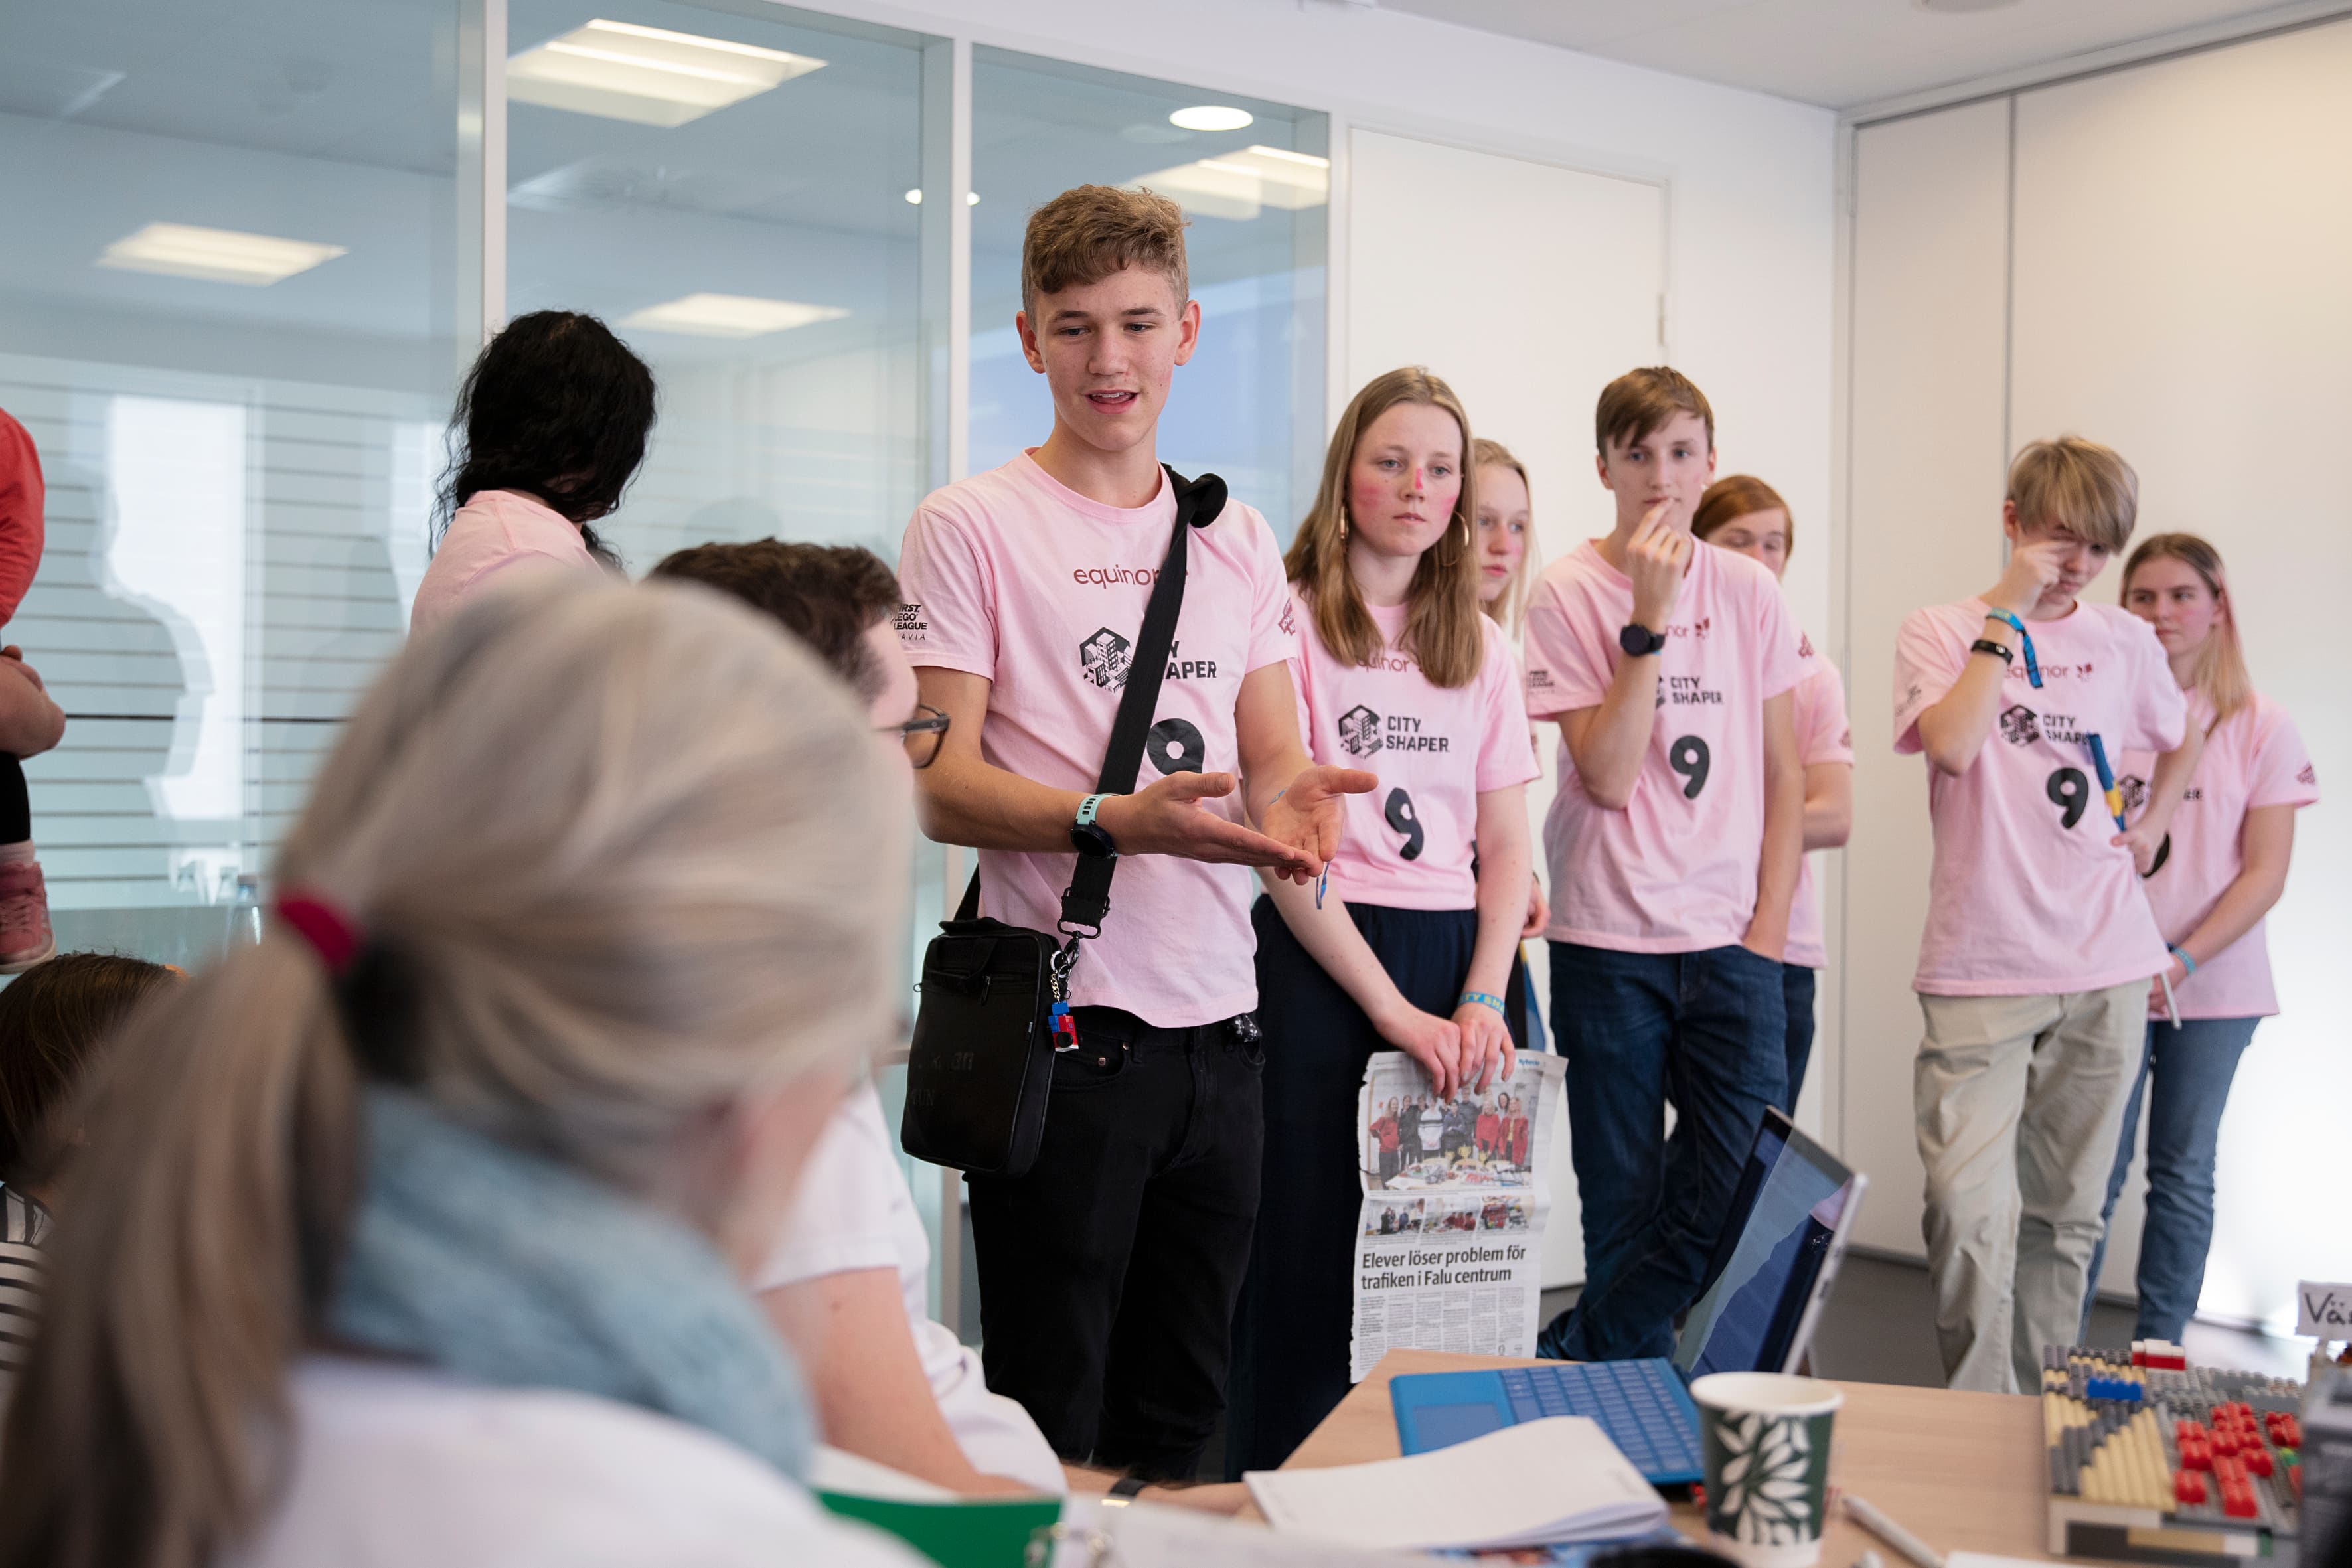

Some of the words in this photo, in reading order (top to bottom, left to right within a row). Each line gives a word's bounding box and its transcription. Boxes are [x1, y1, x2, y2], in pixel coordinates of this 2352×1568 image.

[1073, 564, 1159, 589] equinor
[1165, 661, 1217, 680] APER
[1356, 657, 1409, 672] quinor
[1670, 676, 1700, 689] CITY
[1387, 716, 1421, 732] CITY
[2043, 713, 2076, 727] CITY
[1386, 734, 1449, 752] SHAPER
[1670, 736, 1710, 800] 9
[2047, 767, 2088, 829] 9
[1385, 787, 1424, 861] 9
[1363, 1252, 1406, 1269] Elever
[1408, 1249, 1443, 1265] löser
[1446, 1246, 1504, 1267] problem
[1507, 1245, 1526, 1260] för
[1361, 1272, 1415, 1289] trafiken
[1417, 1271, 1421, 1285] i
[1424, 1269, 1452, 1285] Falu
[1455, 1268, 1512, 1284] centrum
